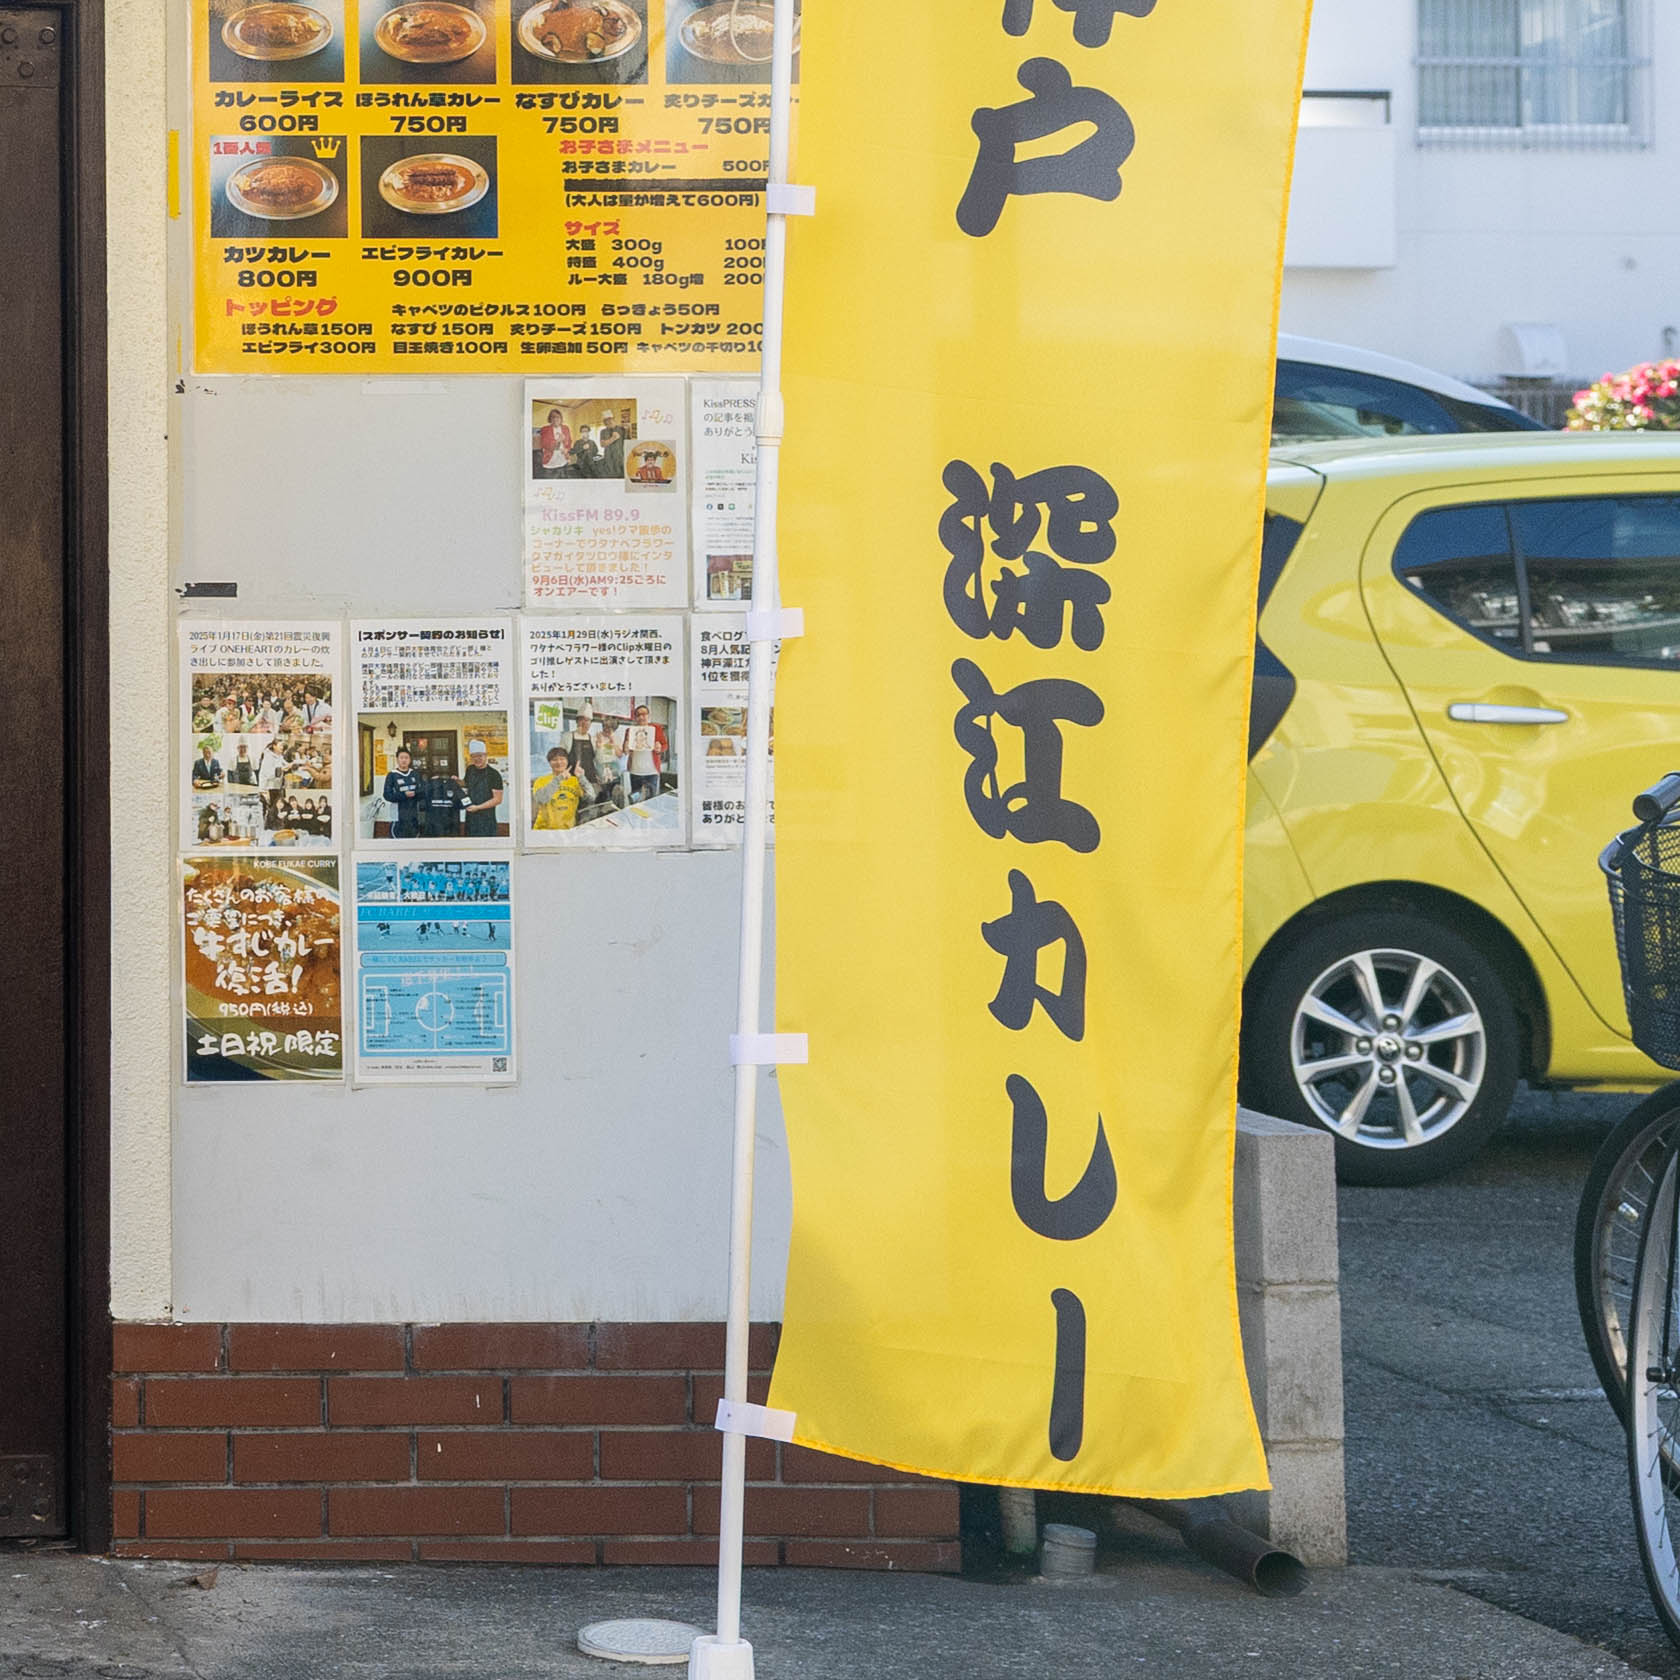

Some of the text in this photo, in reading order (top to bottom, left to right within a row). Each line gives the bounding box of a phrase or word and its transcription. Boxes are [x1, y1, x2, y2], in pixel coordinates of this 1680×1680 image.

[215, 90, 342, 108] カレーライス
[356, 92, 500, 108] ほうれん草カレー
[516, 92, 644, 110] なすびカレー
[240, 115, 319, 132] 600円
[390, 116, 467, 132] 750円
[542, 116, 619, 134] 750円
[559, 140, 709, 155] お子さまメニュー
[561, 160, 676, 174] お子さまカレー
[564, 219, 620, 236] サイズ
[224, 246, 330, 262] カツカレー
[362, 245, 503, 260] エビフライカレー
[566, 239, 662, 254] 大盛 300g
[567, 256, 664, 271] 特盛 400g
[238, 270, 317, 288] 800円
[393, 270, 472, 287] 900円
[568, 273, 628, 286] ルー大盛
[226, 296, 337, 317] トッピング
[391, 322, 494, 336] なすび 150円
[661, 323, 720, 335] トンカツ
[586, 342, 628, 354] 50円
[543, 509, 640, 521] KissFM 89.9
[254, 860, 276, 869] KOBE
[307, 860, 336, 869] CURRY
[193, 926, 335, 961] 牛すじカレー
[939, 460, 1120, 1463] 深江カレー
[197, 1029, 339, 1057] 土日祝 限定
